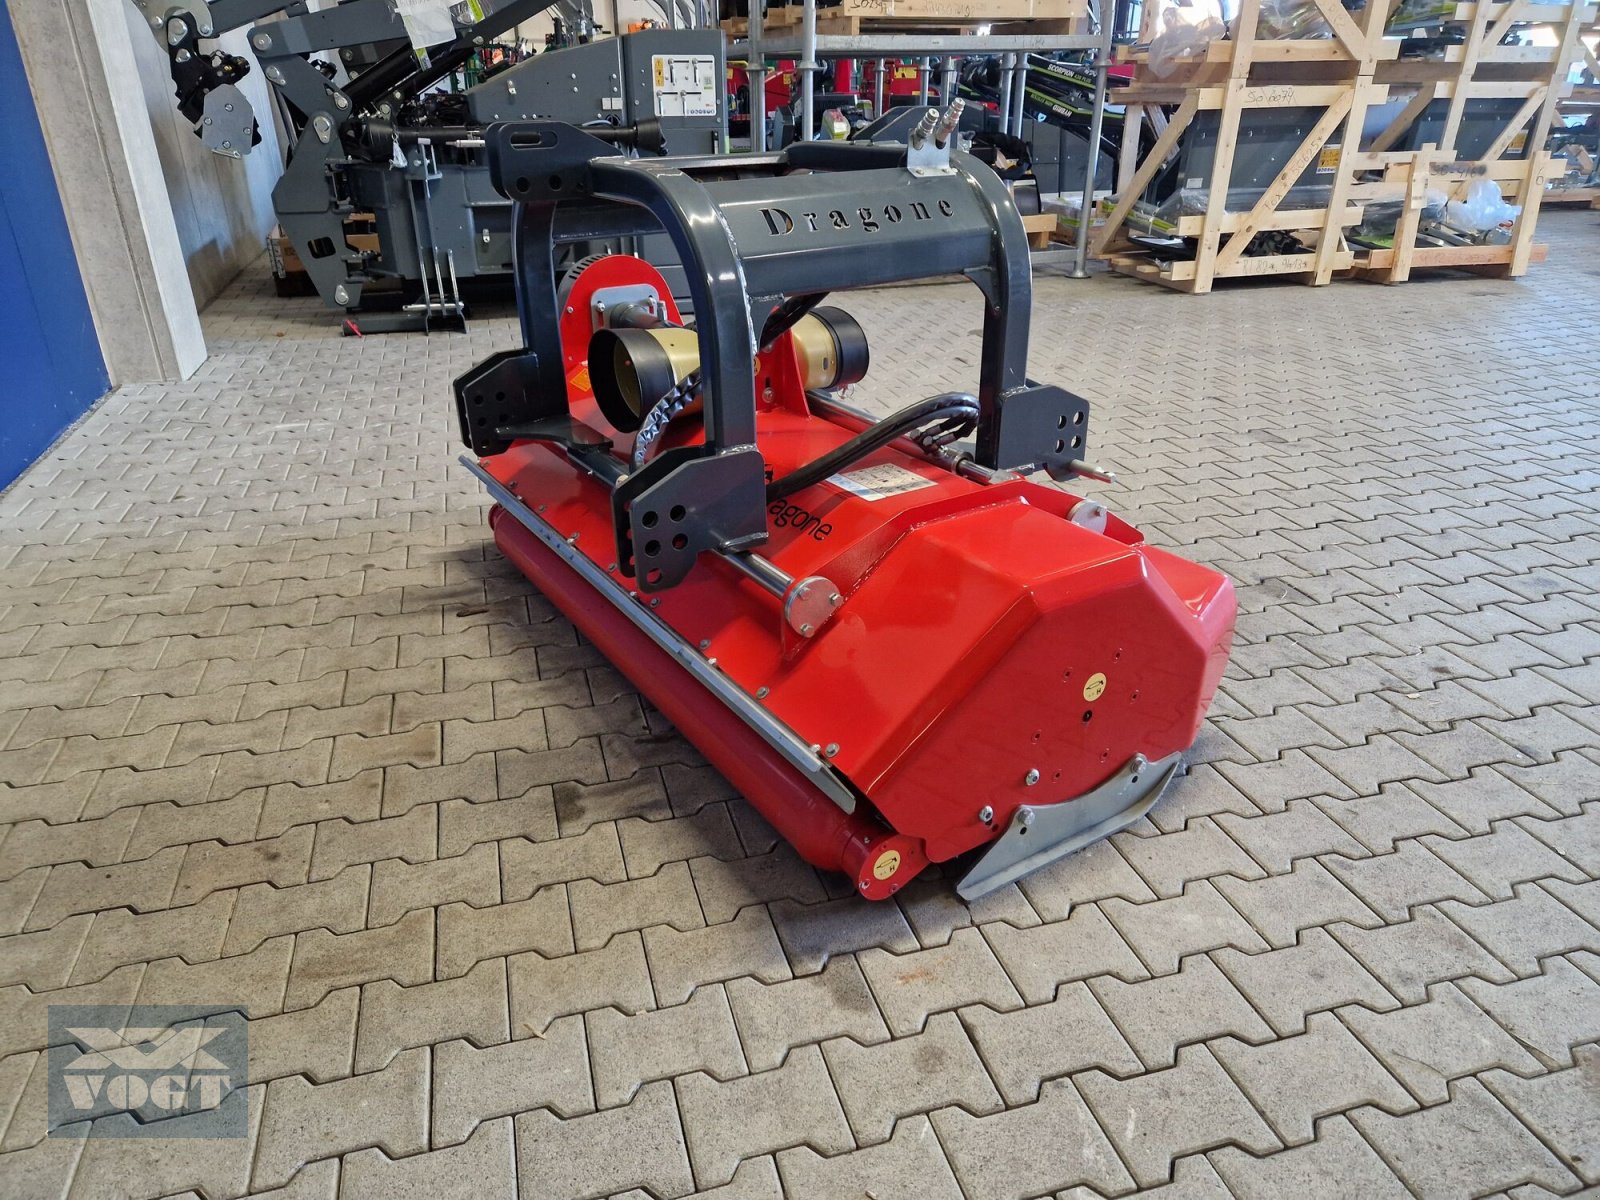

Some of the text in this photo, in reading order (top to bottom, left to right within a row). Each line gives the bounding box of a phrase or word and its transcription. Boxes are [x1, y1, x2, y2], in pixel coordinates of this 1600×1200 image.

[1047, 64, 1074, 77] SCORPION
[1052, 104, 1073, 118] HYBRID
[758, 199, 954, 236] Dragone
[768, 499, 833, 541] agone
